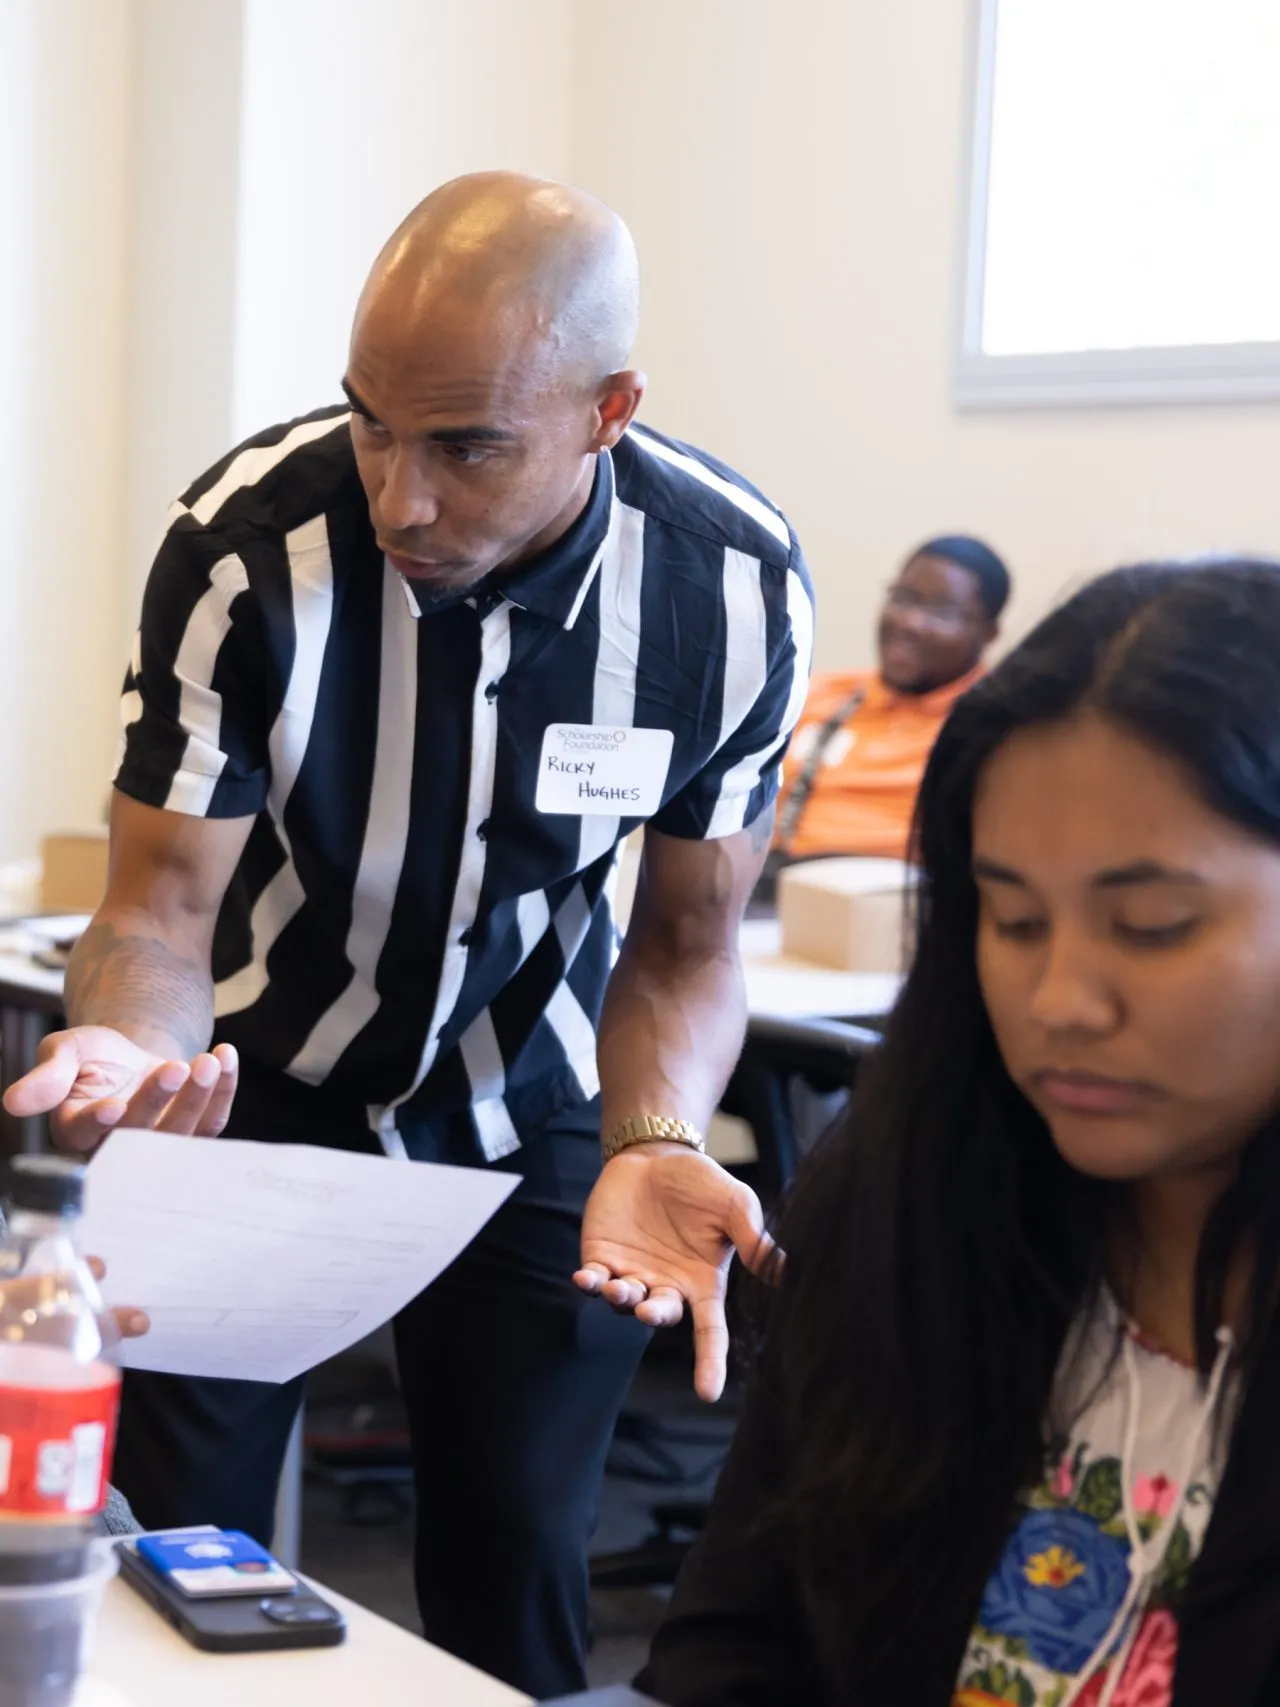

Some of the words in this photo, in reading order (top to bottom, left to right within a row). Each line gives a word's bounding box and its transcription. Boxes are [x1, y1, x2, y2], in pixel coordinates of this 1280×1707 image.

[563, 738, 618, 751] Foundation
[548, 756, 595, 775] RICKY
[578, 781, 640, 800] HUGHES
